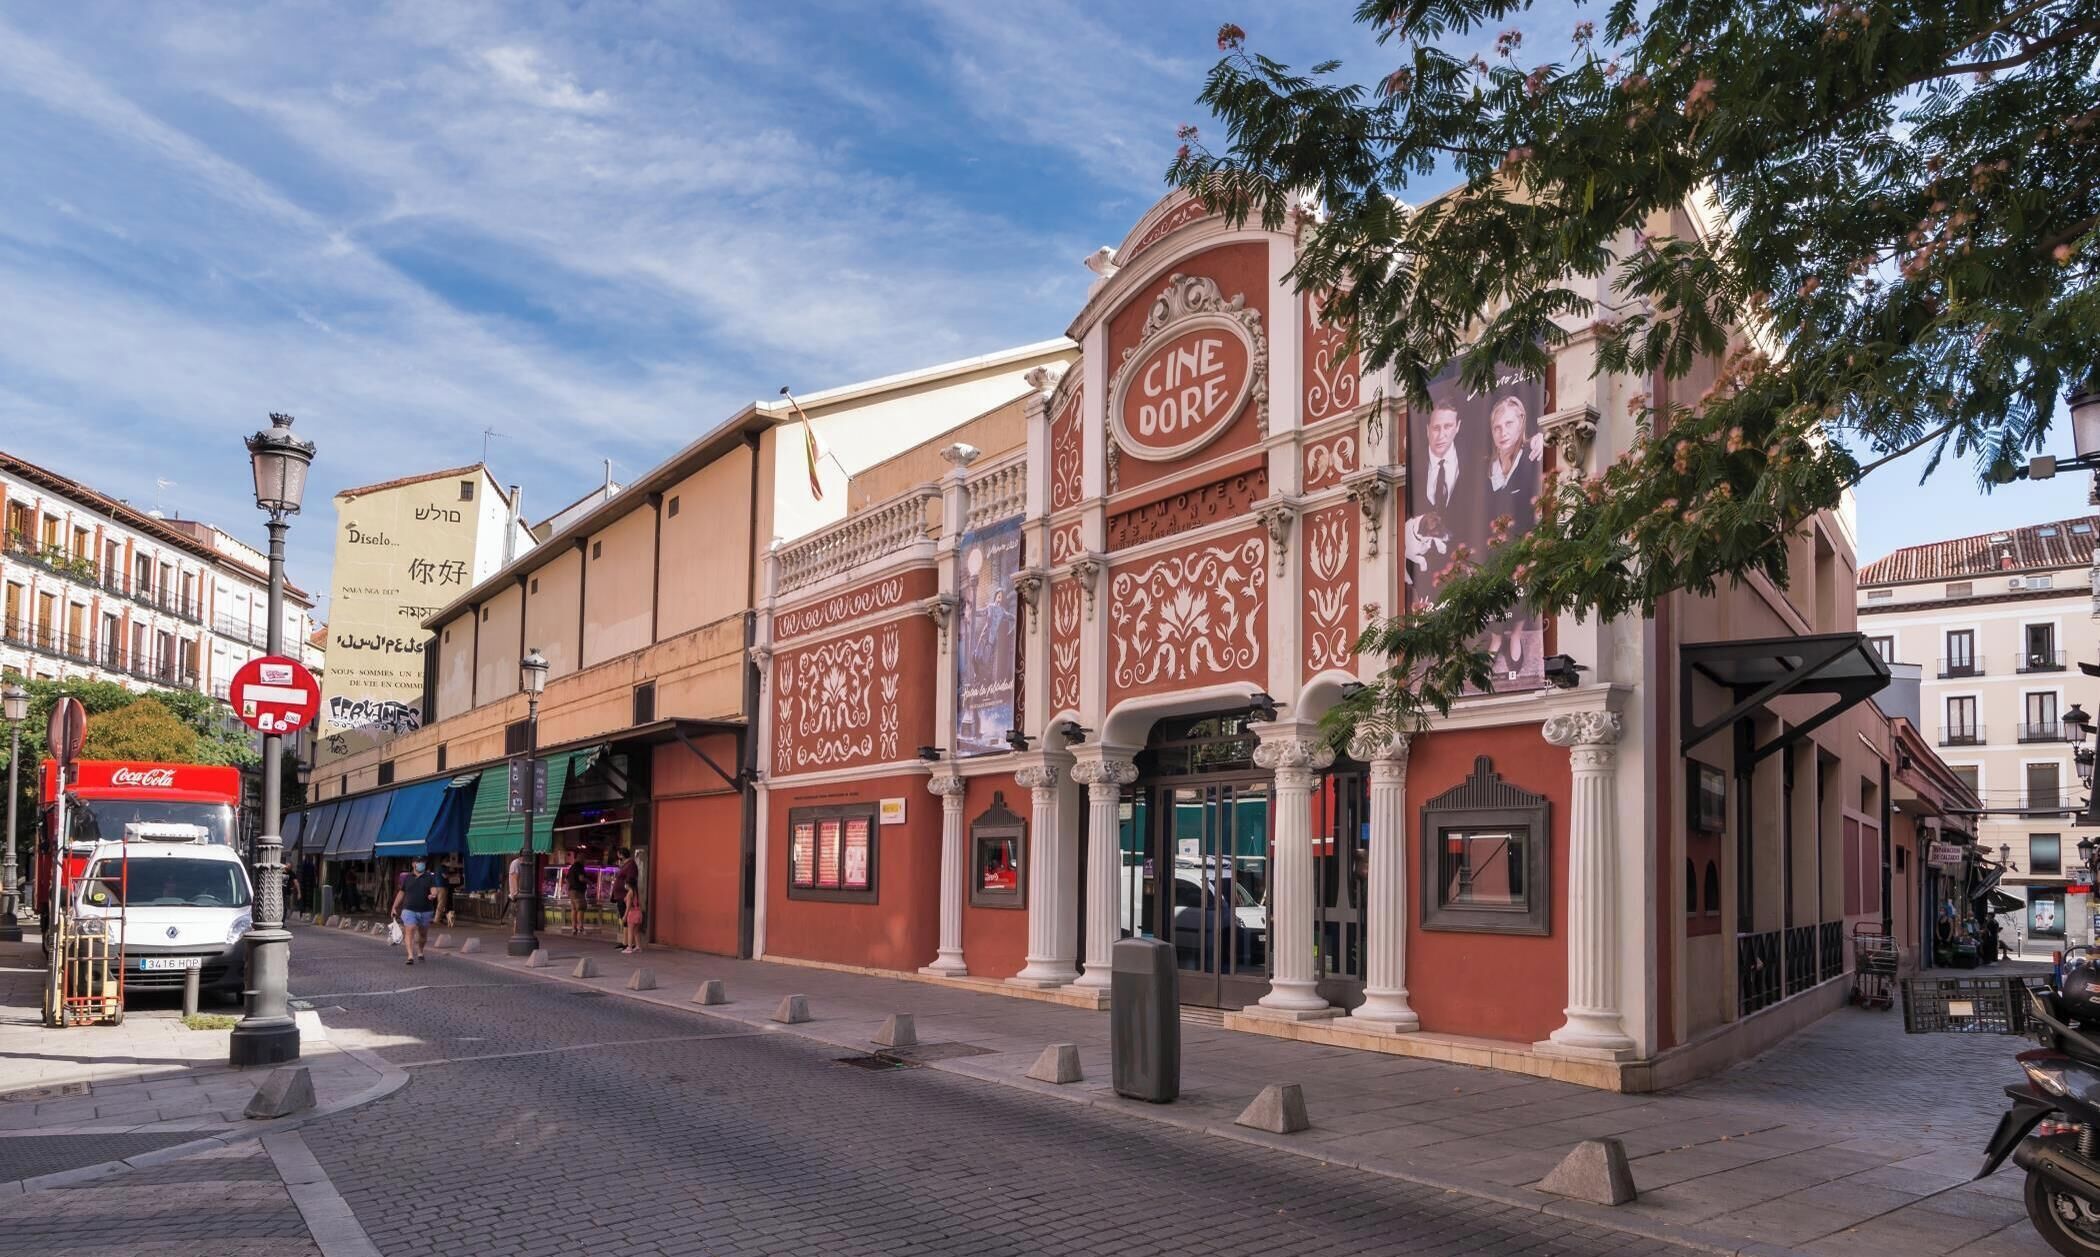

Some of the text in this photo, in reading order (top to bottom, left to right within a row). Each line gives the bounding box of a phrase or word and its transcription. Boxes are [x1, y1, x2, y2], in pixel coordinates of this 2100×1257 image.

[1143, 338, 1224, 398] CINE
[1139, 374, 1229, 437] DORE
[1108, 470, 1267, 534] FILMOTECA
[1119, 490, 1257, 543] ESPAÑOLA
[408, 558, 468, 586] 你好
[330, 668, 355, 676] NOUS
[359, 669, 394, 677] SOMMES
[399, 670, 412, 678] UN
[349, 679, 362, 687] DE
[111, 767, 177, 787] Coca-Cola
[148, 959, 175, 969] 3416
